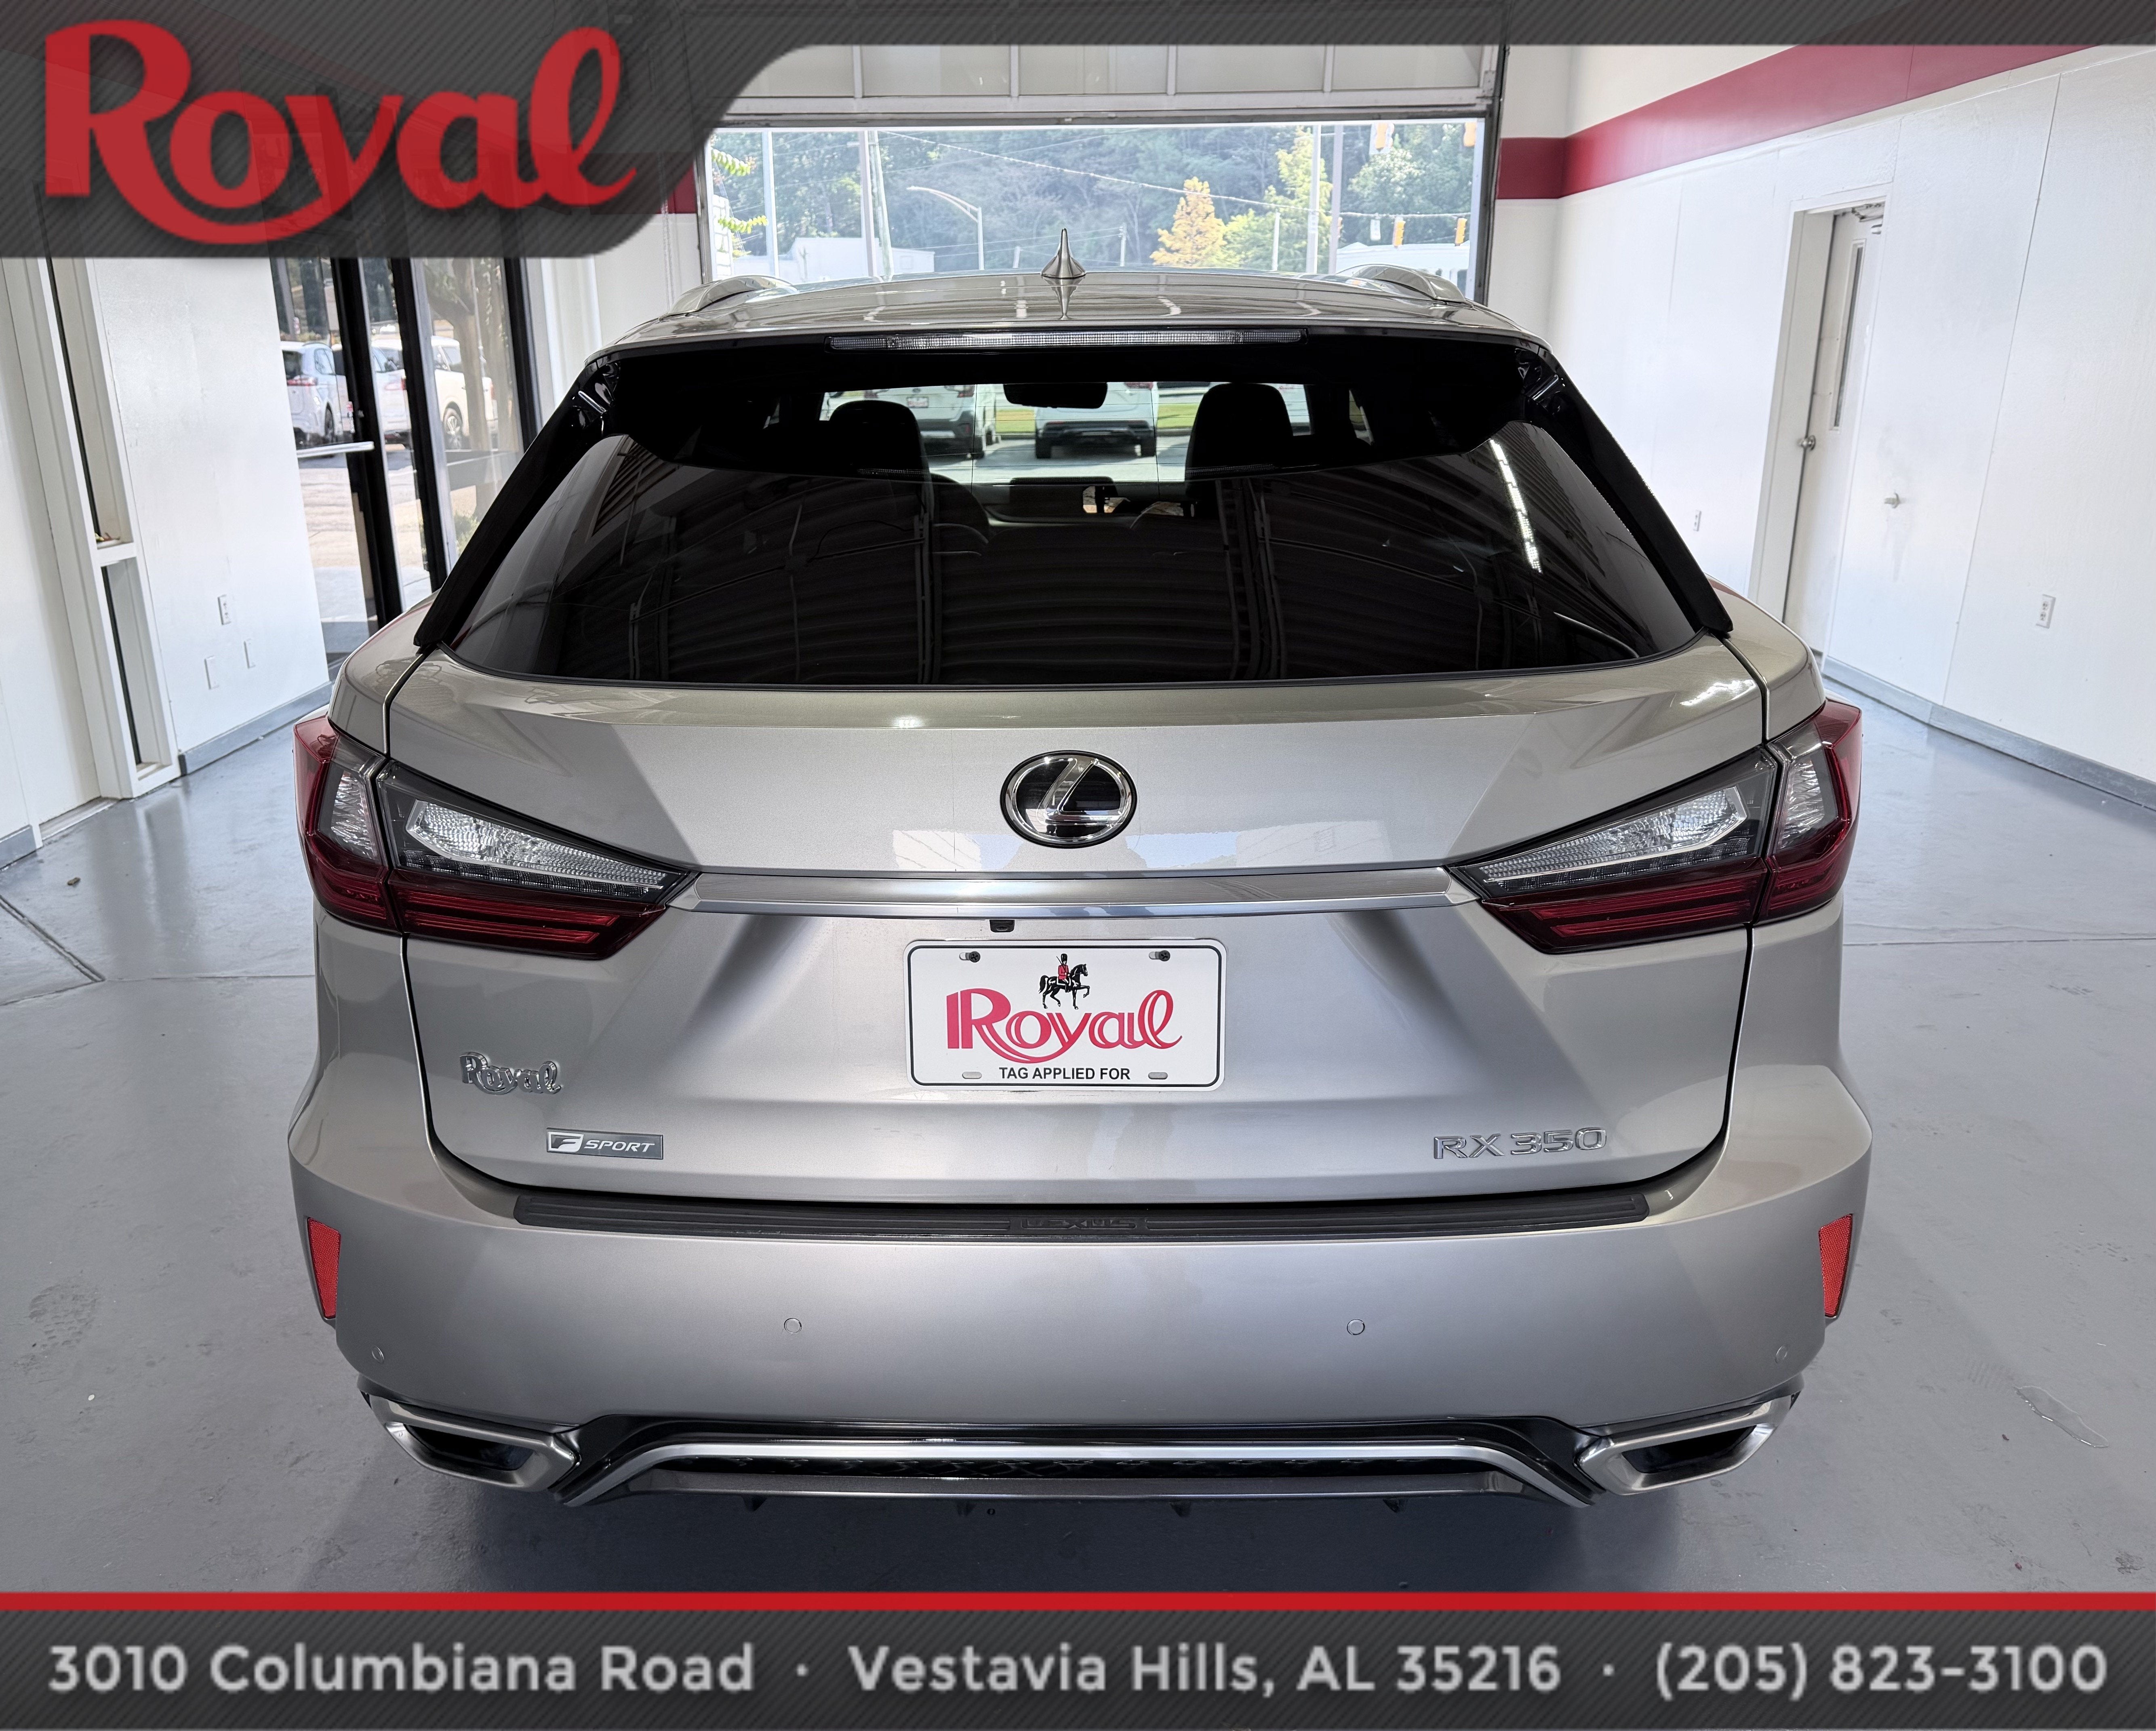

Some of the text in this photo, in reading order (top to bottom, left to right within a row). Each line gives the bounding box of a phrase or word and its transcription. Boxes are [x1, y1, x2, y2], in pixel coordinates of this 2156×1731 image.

[946, 988, 1182, 1064] Royal
[459, 1051, 562, 1095] Royal
[999, 1067, 1131, 1080] TAG APPLIED FOR
[583, 1139, 656, 1153] SPORT
[1434, 1127, 1606, 1159] RX 350
